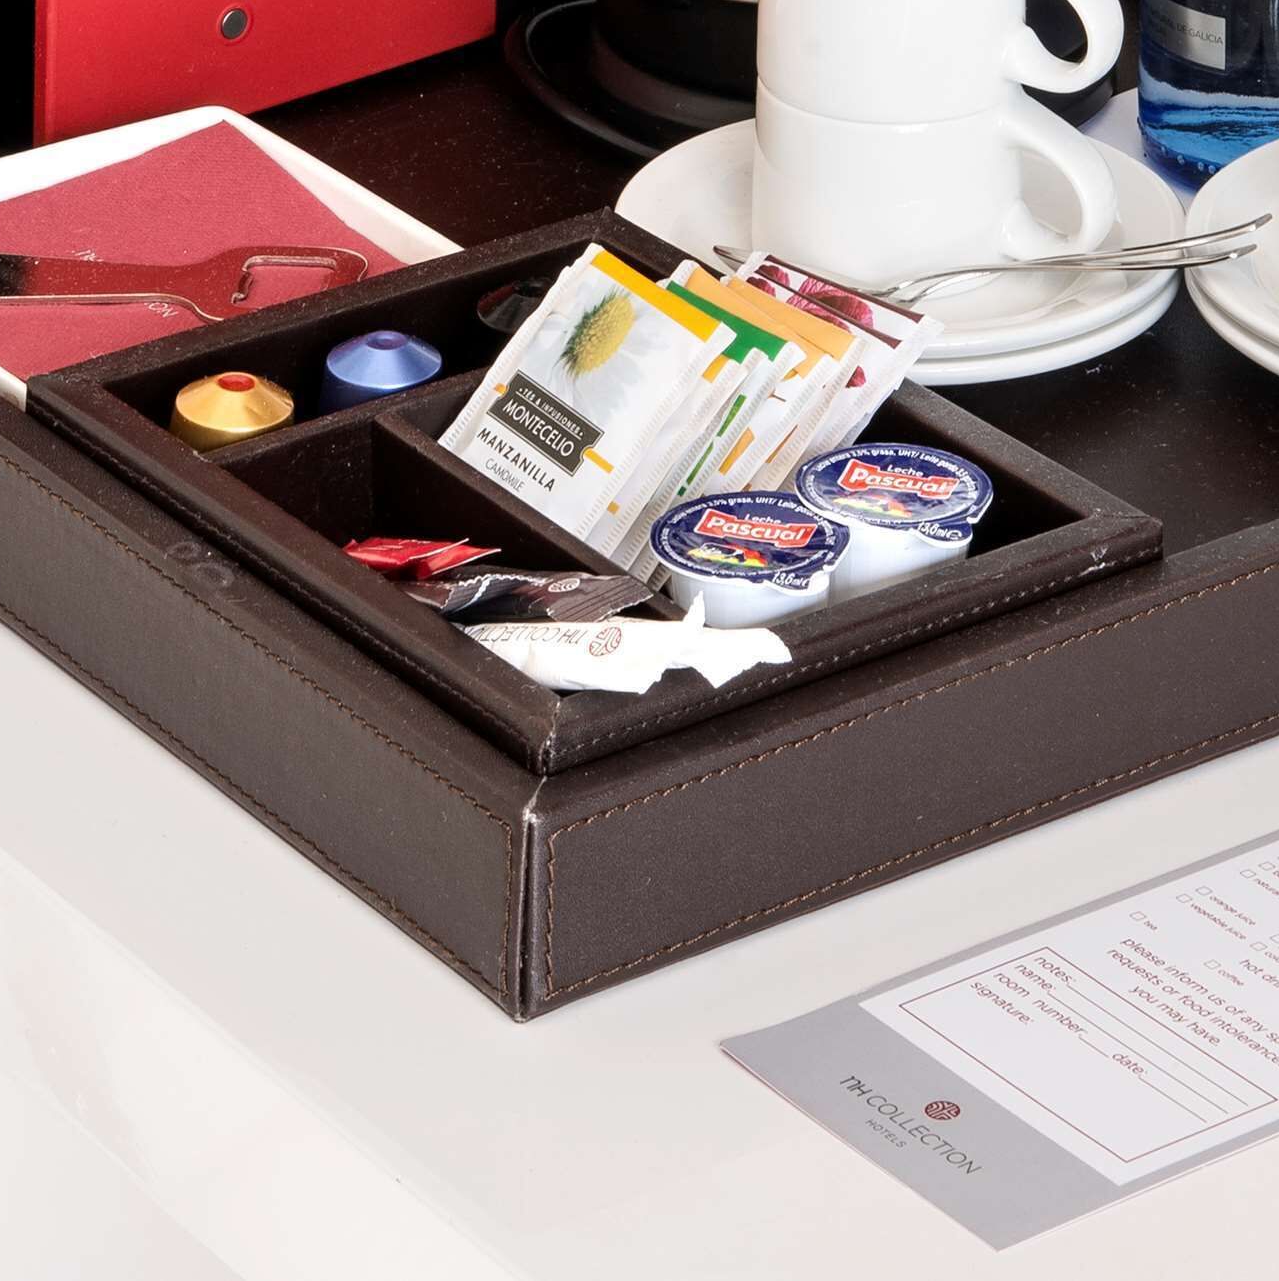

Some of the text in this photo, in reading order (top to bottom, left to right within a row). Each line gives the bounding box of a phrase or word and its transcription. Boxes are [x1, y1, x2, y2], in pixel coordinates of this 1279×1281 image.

[502, 399, 575, 457] MONTECELIO
[477, 427, 556, 492] MANZANILLA
[485, 458, 526, 492] CAMOMILE
[887, 464, 924, 477] Leche
[849, 468, 951, 493] Pascual
[706, 516, 806, 541] Pascual
[744, 513, 782, 525] Leche
[1238, 958, 1264, 975] hot
[992, 972, 1031, 998] room
[1107, 949, 1164, 986] requests
[1160, 984, 1181, 996] or
[1177, 994, 1215, 1018] food
[1119, 938, 1166, 967] please
[1163, 965, 1209, 995] inform
[1206, 993, 1227, 1007] us
[1224, 1004, 1247, 1016] of
[1239, 1015, 1268, 1032] any
[1127, 985, 1159, 1004] you
[1156, 1002, 1189, 1023] may
[864, 1118, 908, 1148] HOTELS
[866, 1094, 981, 1174] COLLECTION
